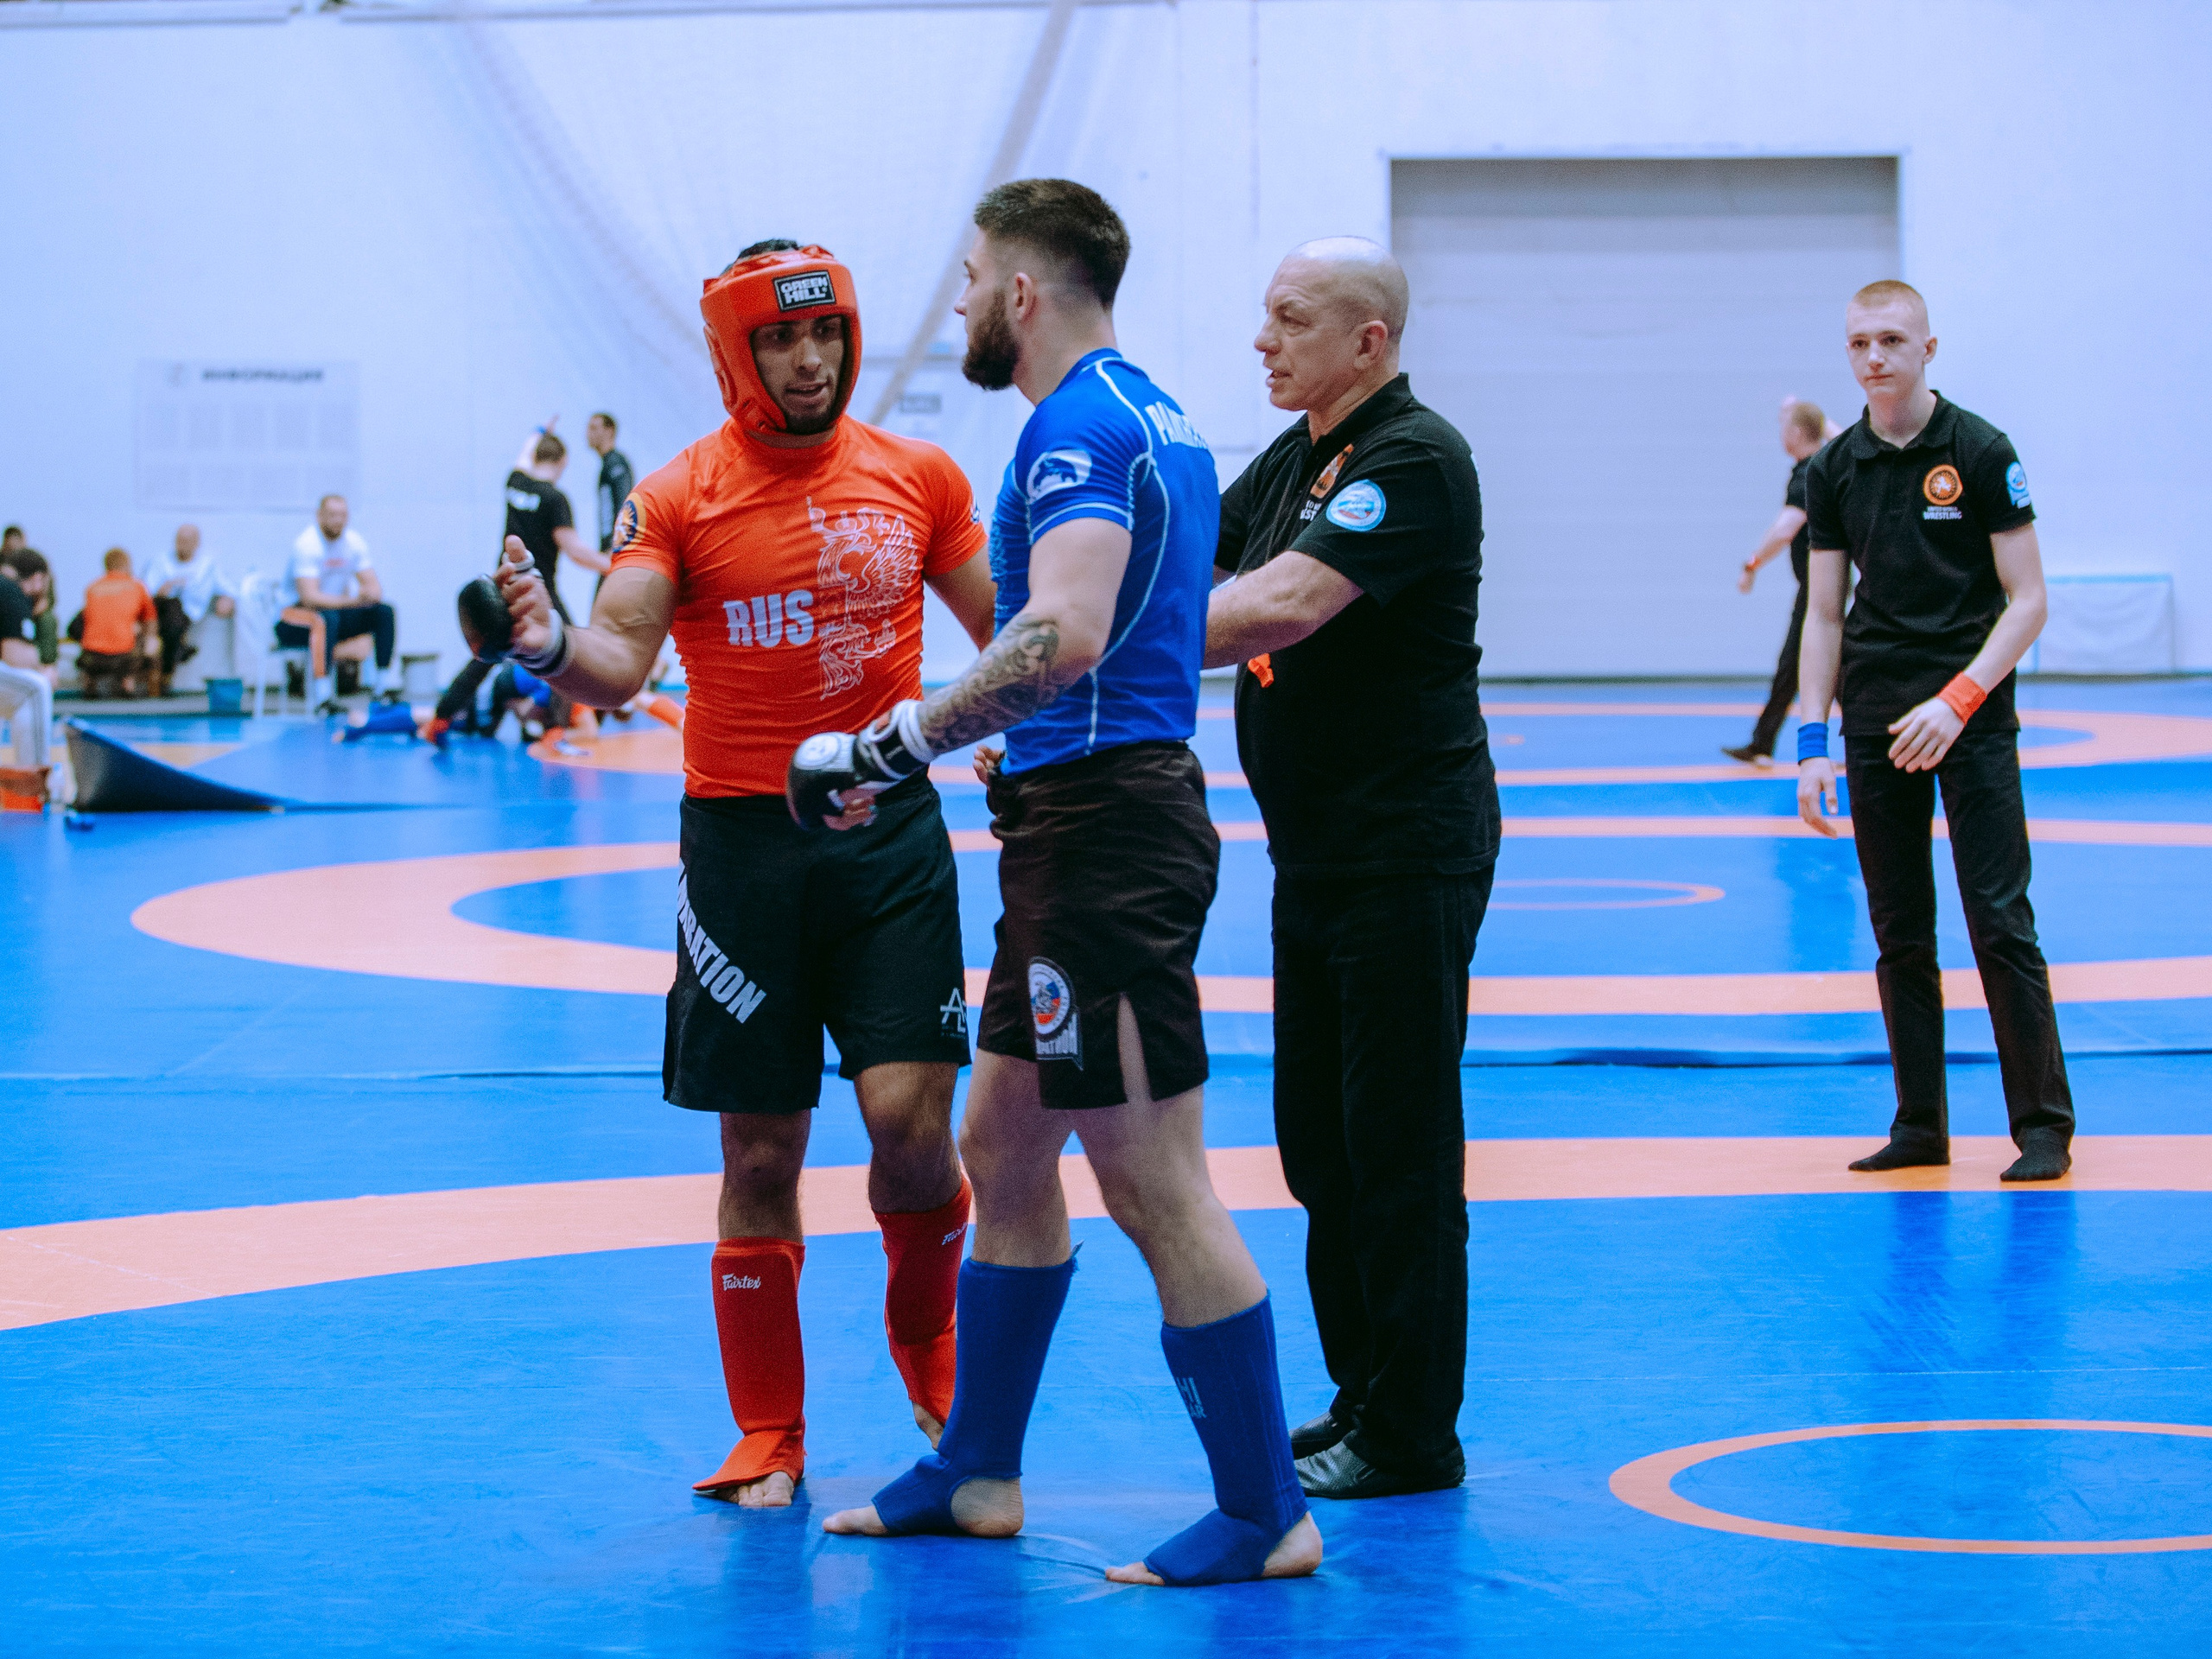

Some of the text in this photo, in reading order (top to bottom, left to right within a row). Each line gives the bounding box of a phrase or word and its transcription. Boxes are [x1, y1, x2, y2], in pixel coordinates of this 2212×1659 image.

[784, 286, 826, 305] HILL
[1923, 511, 1962, 520] WRESTLING
[723, 589, 814, 647] RUS
[721, 1273, 761, 1292] Fairtex
